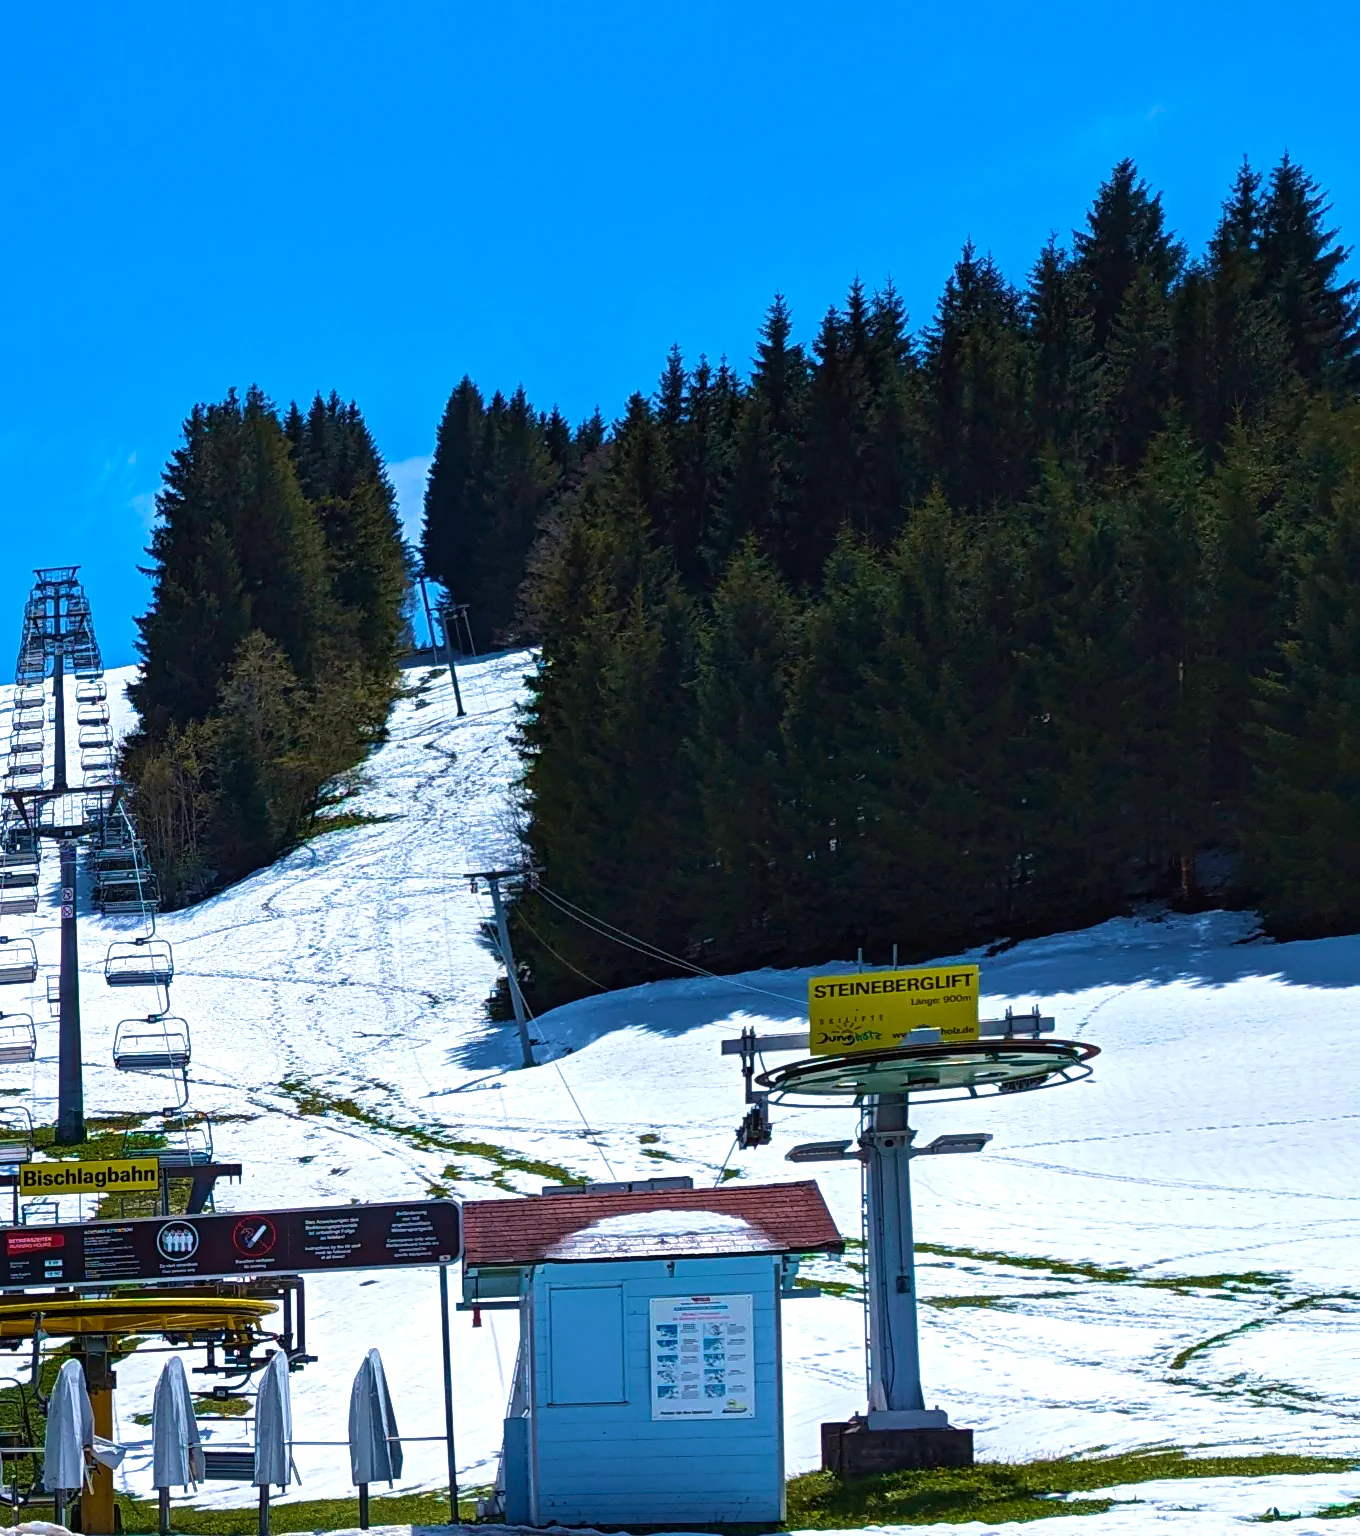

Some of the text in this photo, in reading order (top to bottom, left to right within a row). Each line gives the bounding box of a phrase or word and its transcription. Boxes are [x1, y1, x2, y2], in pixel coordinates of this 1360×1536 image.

[814, 973, 974, 999] STEINEBERGLIFT
[943, 994, 972, 1003] 900m
[815, 1030, 882, 1046] Jungholz
[23, 1165, 155, 1187] Bischlagbahn
